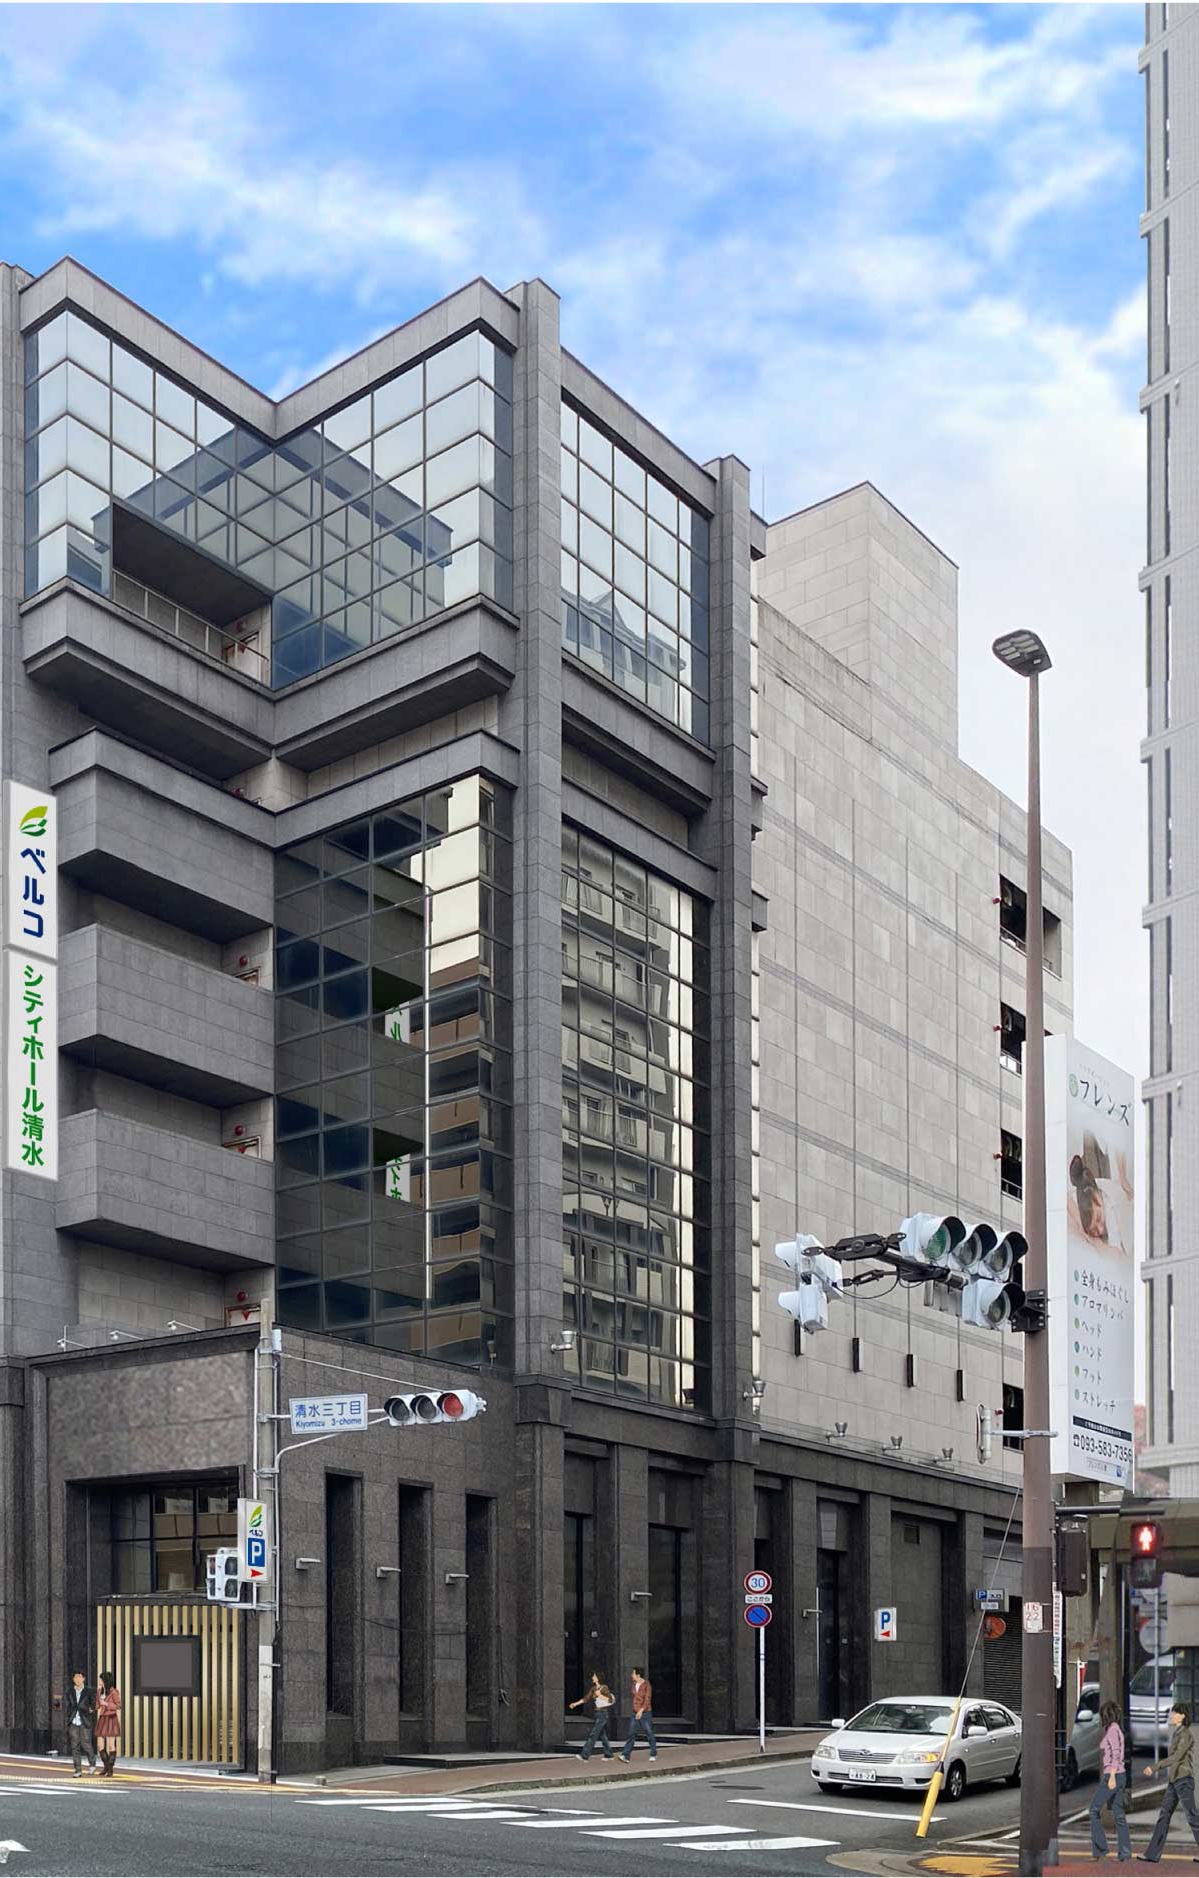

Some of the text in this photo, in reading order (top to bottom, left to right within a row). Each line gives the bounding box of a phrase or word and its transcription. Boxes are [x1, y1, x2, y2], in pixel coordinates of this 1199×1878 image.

[20, 847, 47, 939] ベルコ
[21, 964, 45, 1167] シティホール清水
[1080, 1079, 1132, 1127] フレンズ
[295, 1401, 361, 1418] 清水三丁目
[295, 1418, 362, 1430] Kiyomizu 3-chome
[251, 1541, 263, 1565] P
[751, 1577, 765, 1588] 30
[979, 1590, 987, 1599] P
[881, 1611, 891, 1629] P
